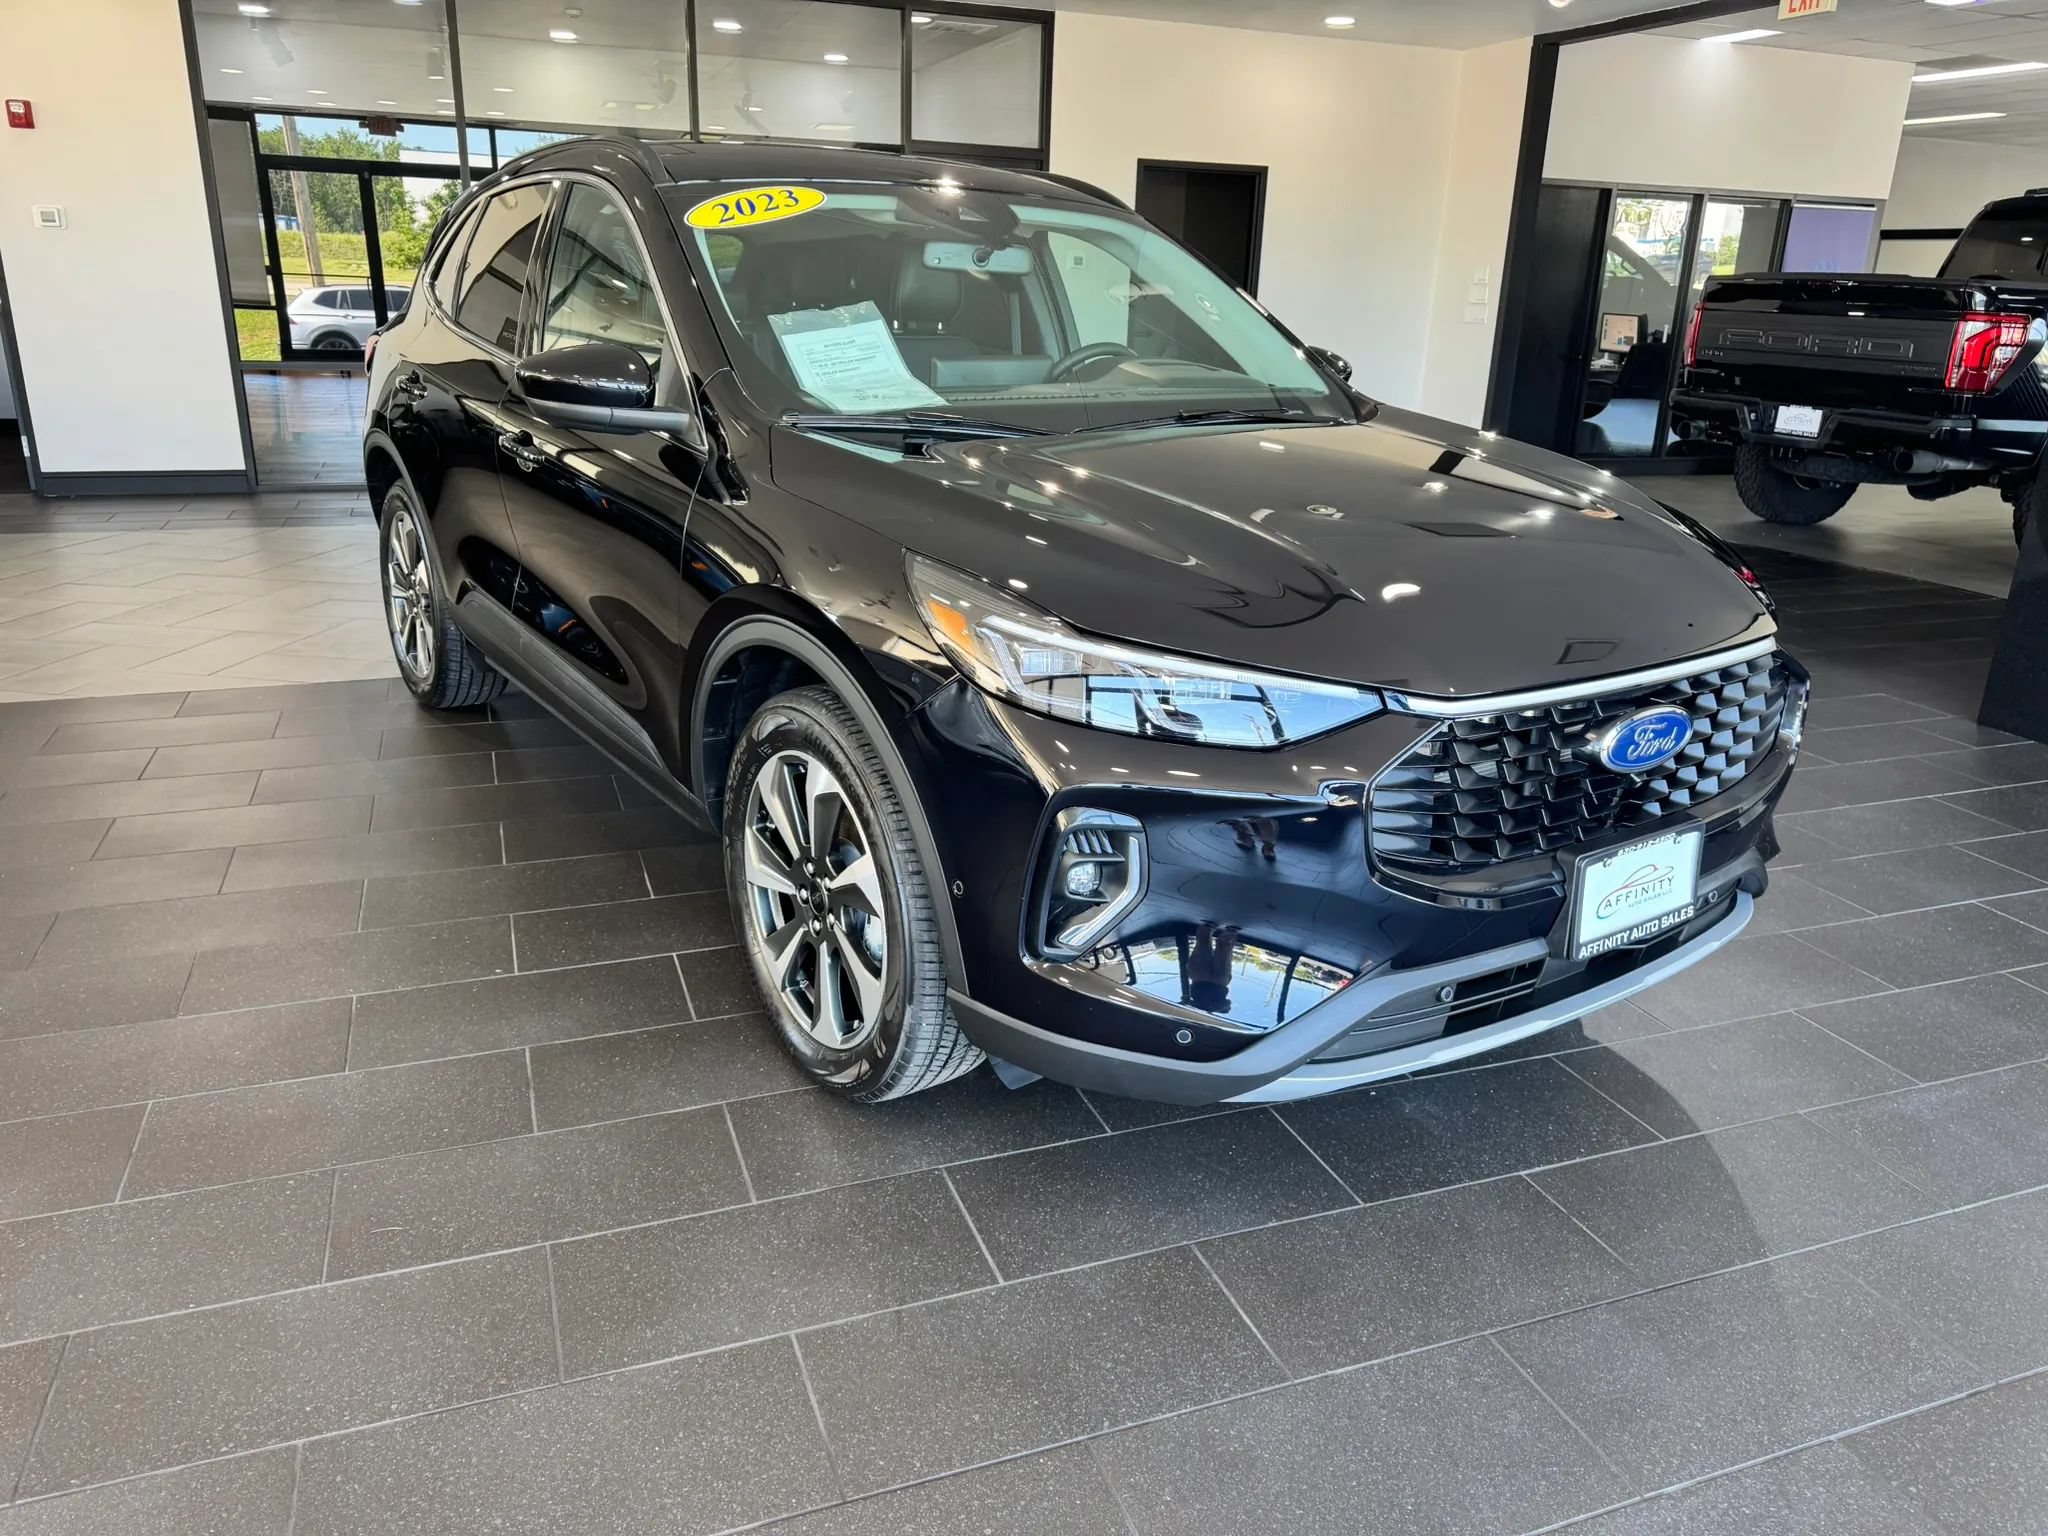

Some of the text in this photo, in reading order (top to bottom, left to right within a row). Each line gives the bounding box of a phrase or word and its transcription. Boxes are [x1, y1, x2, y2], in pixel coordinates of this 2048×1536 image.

[711, 189, 799, 225] 2023
[1719, 328, 1914, 358] FORD
[1627, 721, 1679, 760] Ford
[1603, 875, 1674, 910] AFFINITY
[1578, 905, 1695, 959] AFFINITY AUTO SALES
